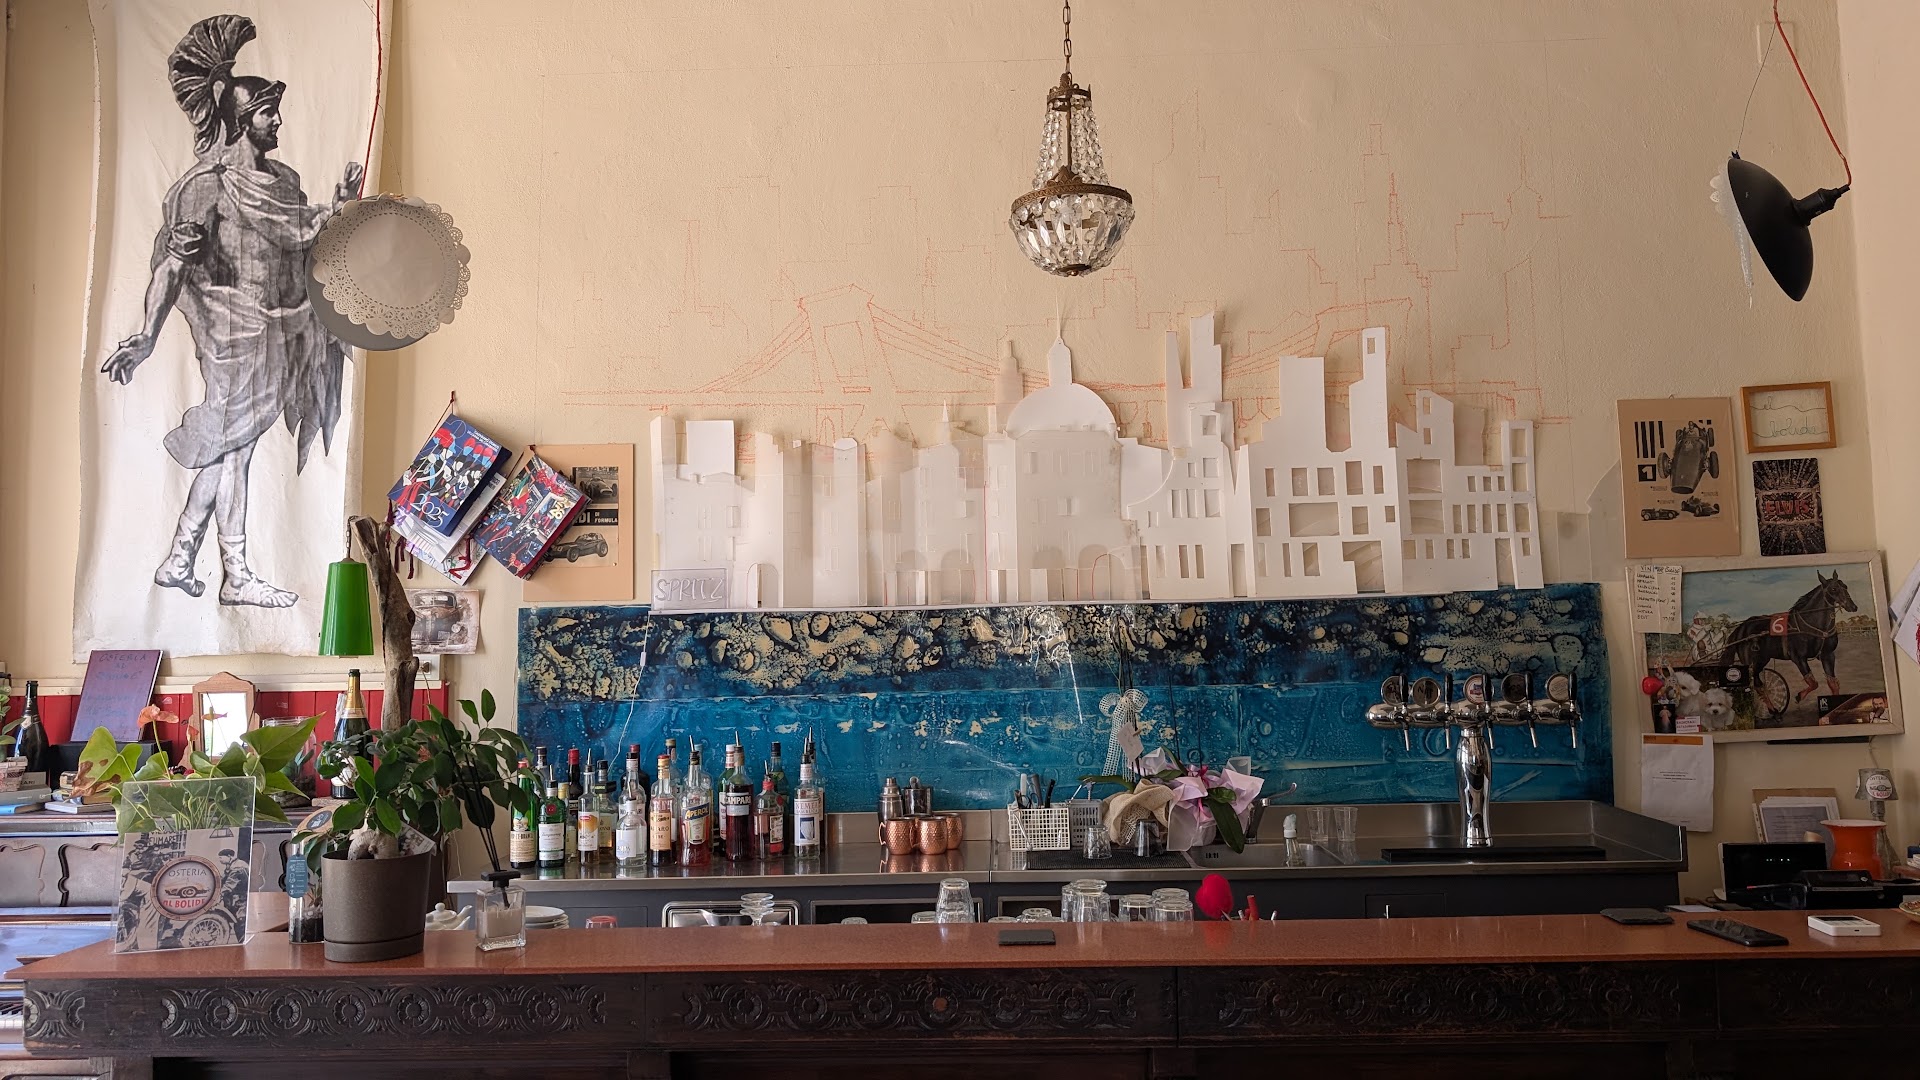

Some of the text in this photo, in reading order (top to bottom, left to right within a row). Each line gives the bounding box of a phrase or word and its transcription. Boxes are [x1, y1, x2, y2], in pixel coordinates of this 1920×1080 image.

[410, 493, 450, 528] 2025
[1765, 500, 1810, 515] ELVIS
[655, 577, 724, 602] SPRITZ
[1771, 617, 1785, 633] 6
[724, 795, 752, 805] CAMPARI
[685, 806, 709, 820] APEROL
[168, 867, 207, 878] OSTERIA
